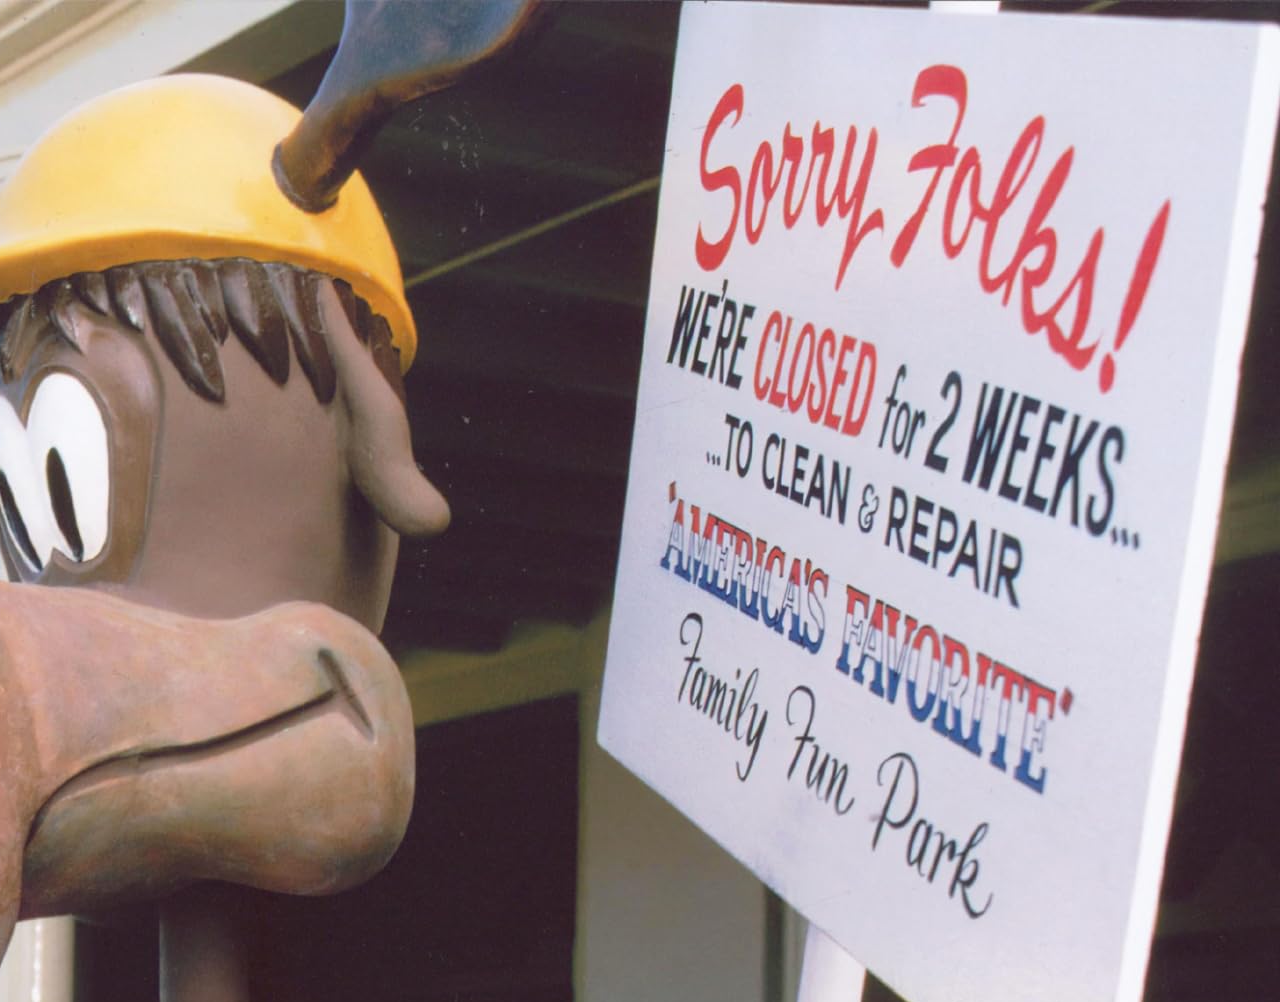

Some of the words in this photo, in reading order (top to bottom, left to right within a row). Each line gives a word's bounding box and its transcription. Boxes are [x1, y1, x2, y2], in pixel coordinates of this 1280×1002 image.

[695, 83, 884, 292] Sorry
[890, 64, 1171, 394] Folks!
[666, 279, 756, 390] WE'RE
[753, 310, 877, 437] CLOSED
[878, 364, 926, 459] for
[924, 370, 963, 473] 2
[961, 382, 1140, 550] WEEKS...
[706, 413, 754, 478] ...TO
[761, 433, 851, 525] CLEAN
[858, 483, 880, 533] &
[884, 487, 1022, 609] REPAIR
[678, 613, 769, 782] Family
[785, 685, 854, 816] Fun
[872, 752, 994, 919] Park
